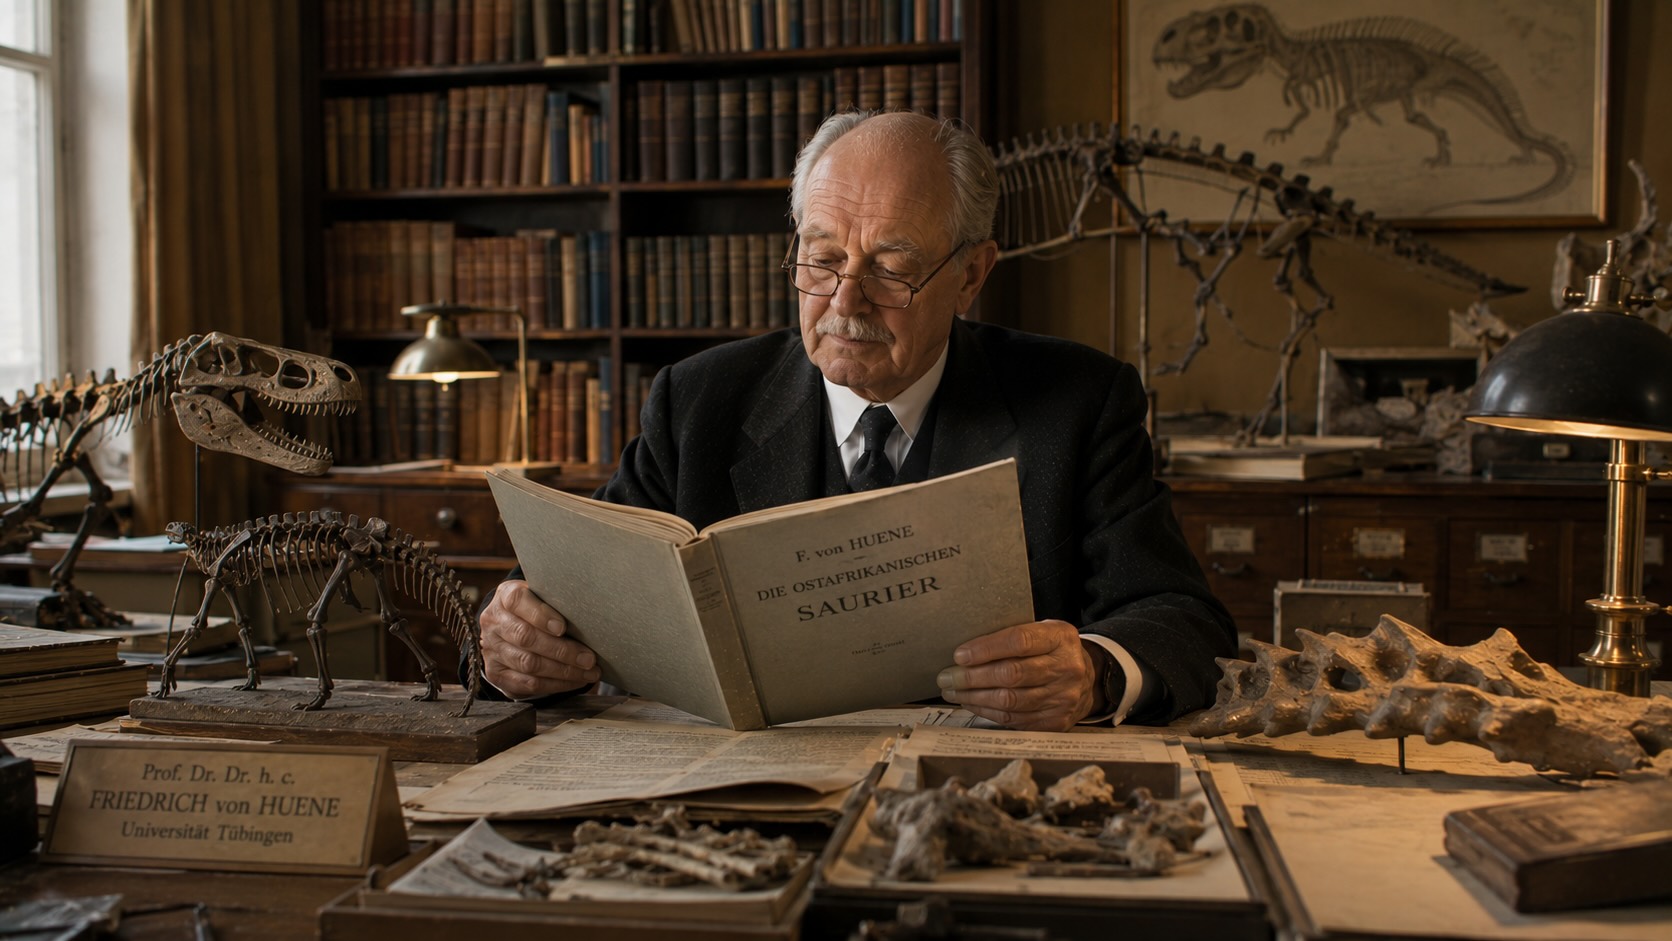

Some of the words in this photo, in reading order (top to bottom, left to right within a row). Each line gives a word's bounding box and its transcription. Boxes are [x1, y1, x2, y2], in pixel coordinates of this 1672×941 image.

[795, 549, 810, 563] F.
[816, 545, 844, 559] von
[849, 525, 915, 551] HUENE
[757, 585, 788, 602] DIE
[792, 545, 962, 594] OSTAFRIKANISCHEN
[797, 576, 942, 622] SAURIER
[141, 763, 183, 782] Prof.
[189, 764, 217, 782] Dr.
[224, 765, 252, 784] Dr.
[258, 767, 275, 785] h.
[281, 771, 296, 786] c.
[88, 790, 209, 813] FRIEDRICH
[215, 799, 250, 815] von
[258, 796, 341, 818] HUENE
[121, 821, 210, 840] Universität
[217, 824, 294, 847] Tübingen
